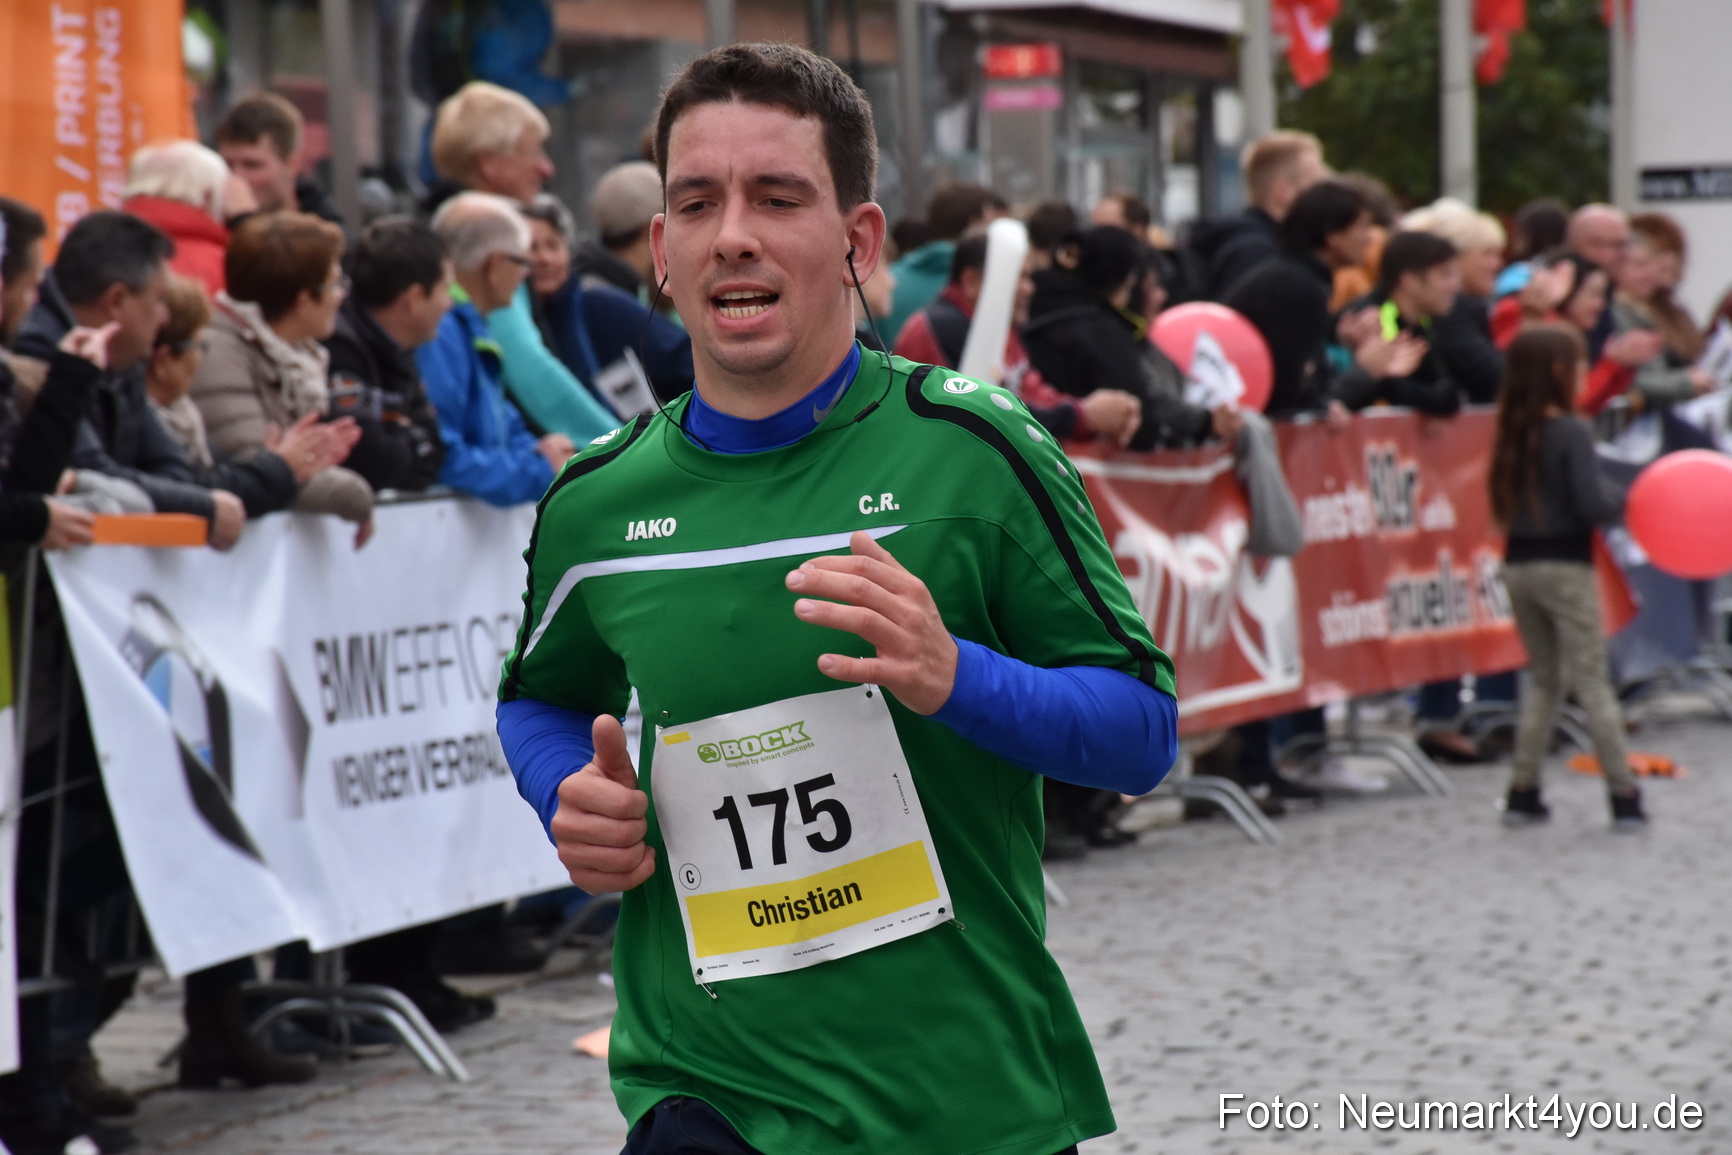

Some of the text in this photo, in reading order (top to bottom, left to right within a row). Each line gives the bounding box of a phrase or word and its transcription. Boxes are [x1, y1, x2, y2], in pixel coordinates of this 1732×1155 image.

[52, 3, 88, 146] PRINT
[859, 492, 900, 515] C.R.
[625, 517, 677, 542] JAKO
[313, 632, 388, 726] BMW
[719, 721, 812, 760] BOCK
[726, 741, 815, 768] inspired by smart concepts
[712, 773, 852, 870] 175
[685, 870, 695, 884] C
[747, 882, 863, 927] Christian
